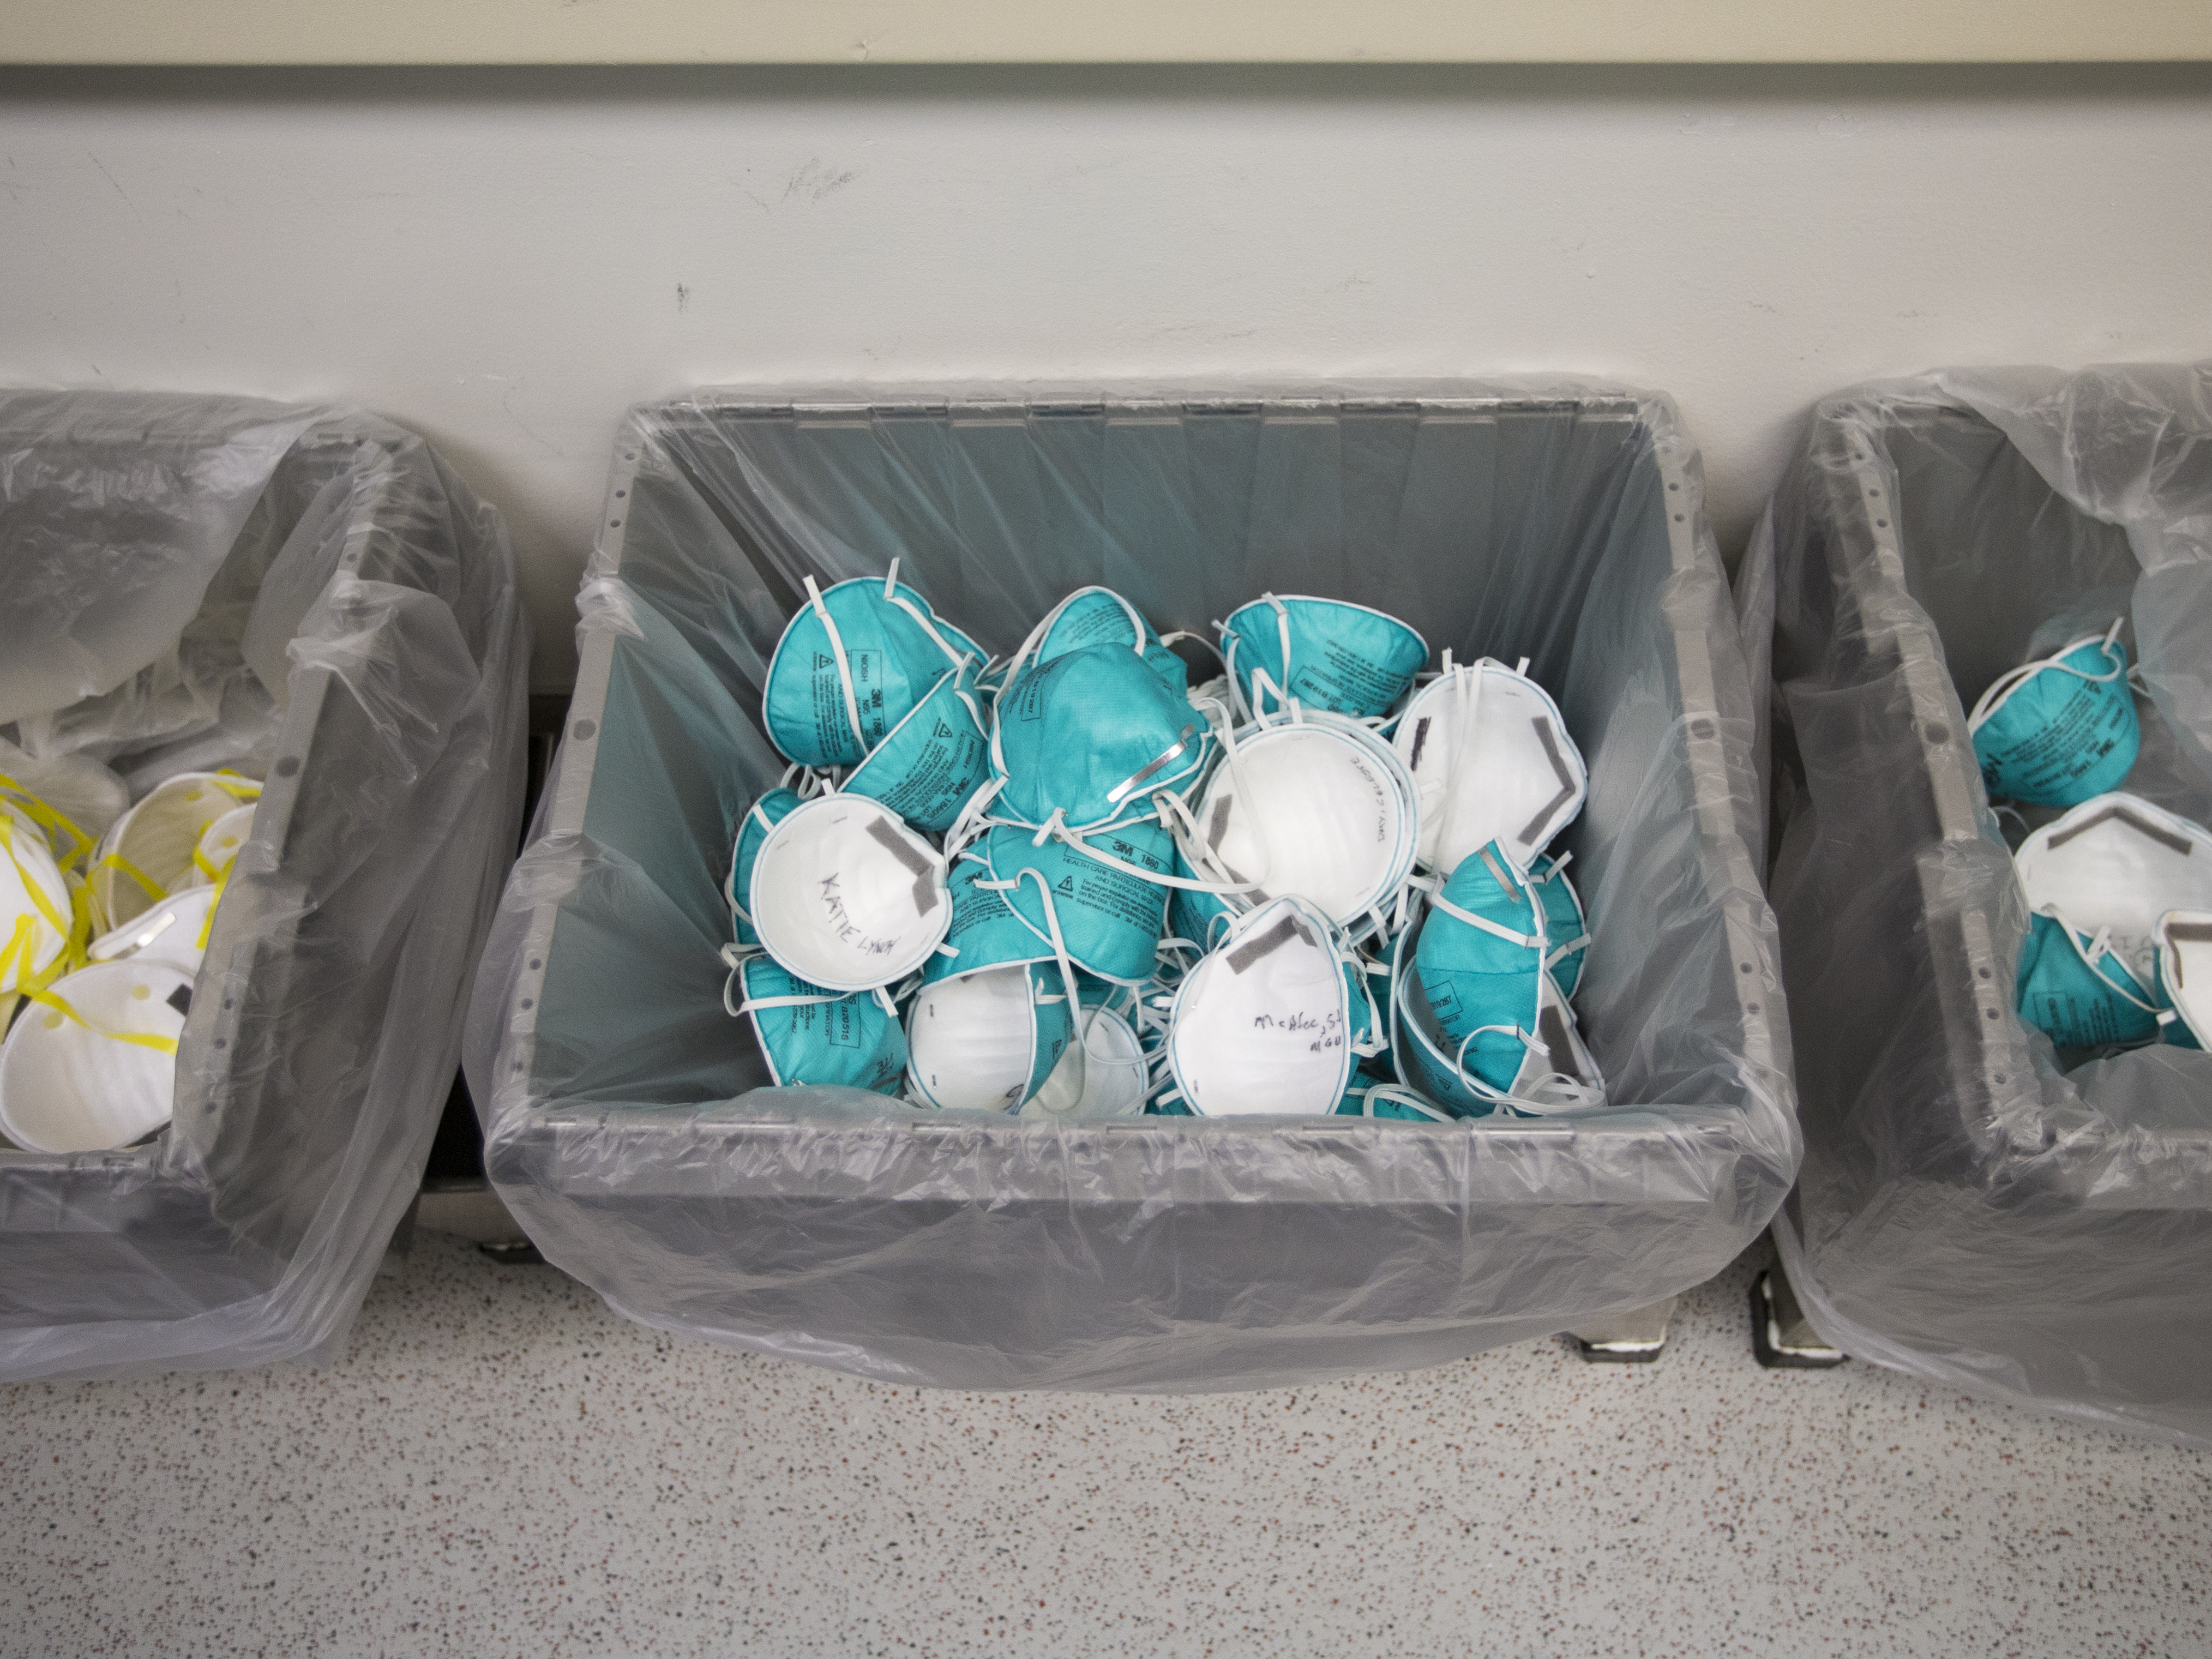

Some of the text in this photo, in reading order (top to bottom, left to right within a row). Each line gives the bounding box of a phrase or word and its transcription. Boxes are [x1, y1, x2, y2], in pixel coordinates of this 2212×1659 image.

[871, 688, 881, 707] 3M
[962, 741, 975, 768] NIOSH
[941, 781, 955, 796] N95
[952, 776, 970, 796] 3M
[1111, 841, 1159, 869] 3M 1860
[1062, 857, 1089, 869] HEALTH
[1090, 865, 1109, 876] CARE
[1094, 875, 1109, 884] AND
[818, 872, 861, 943] KATIE
